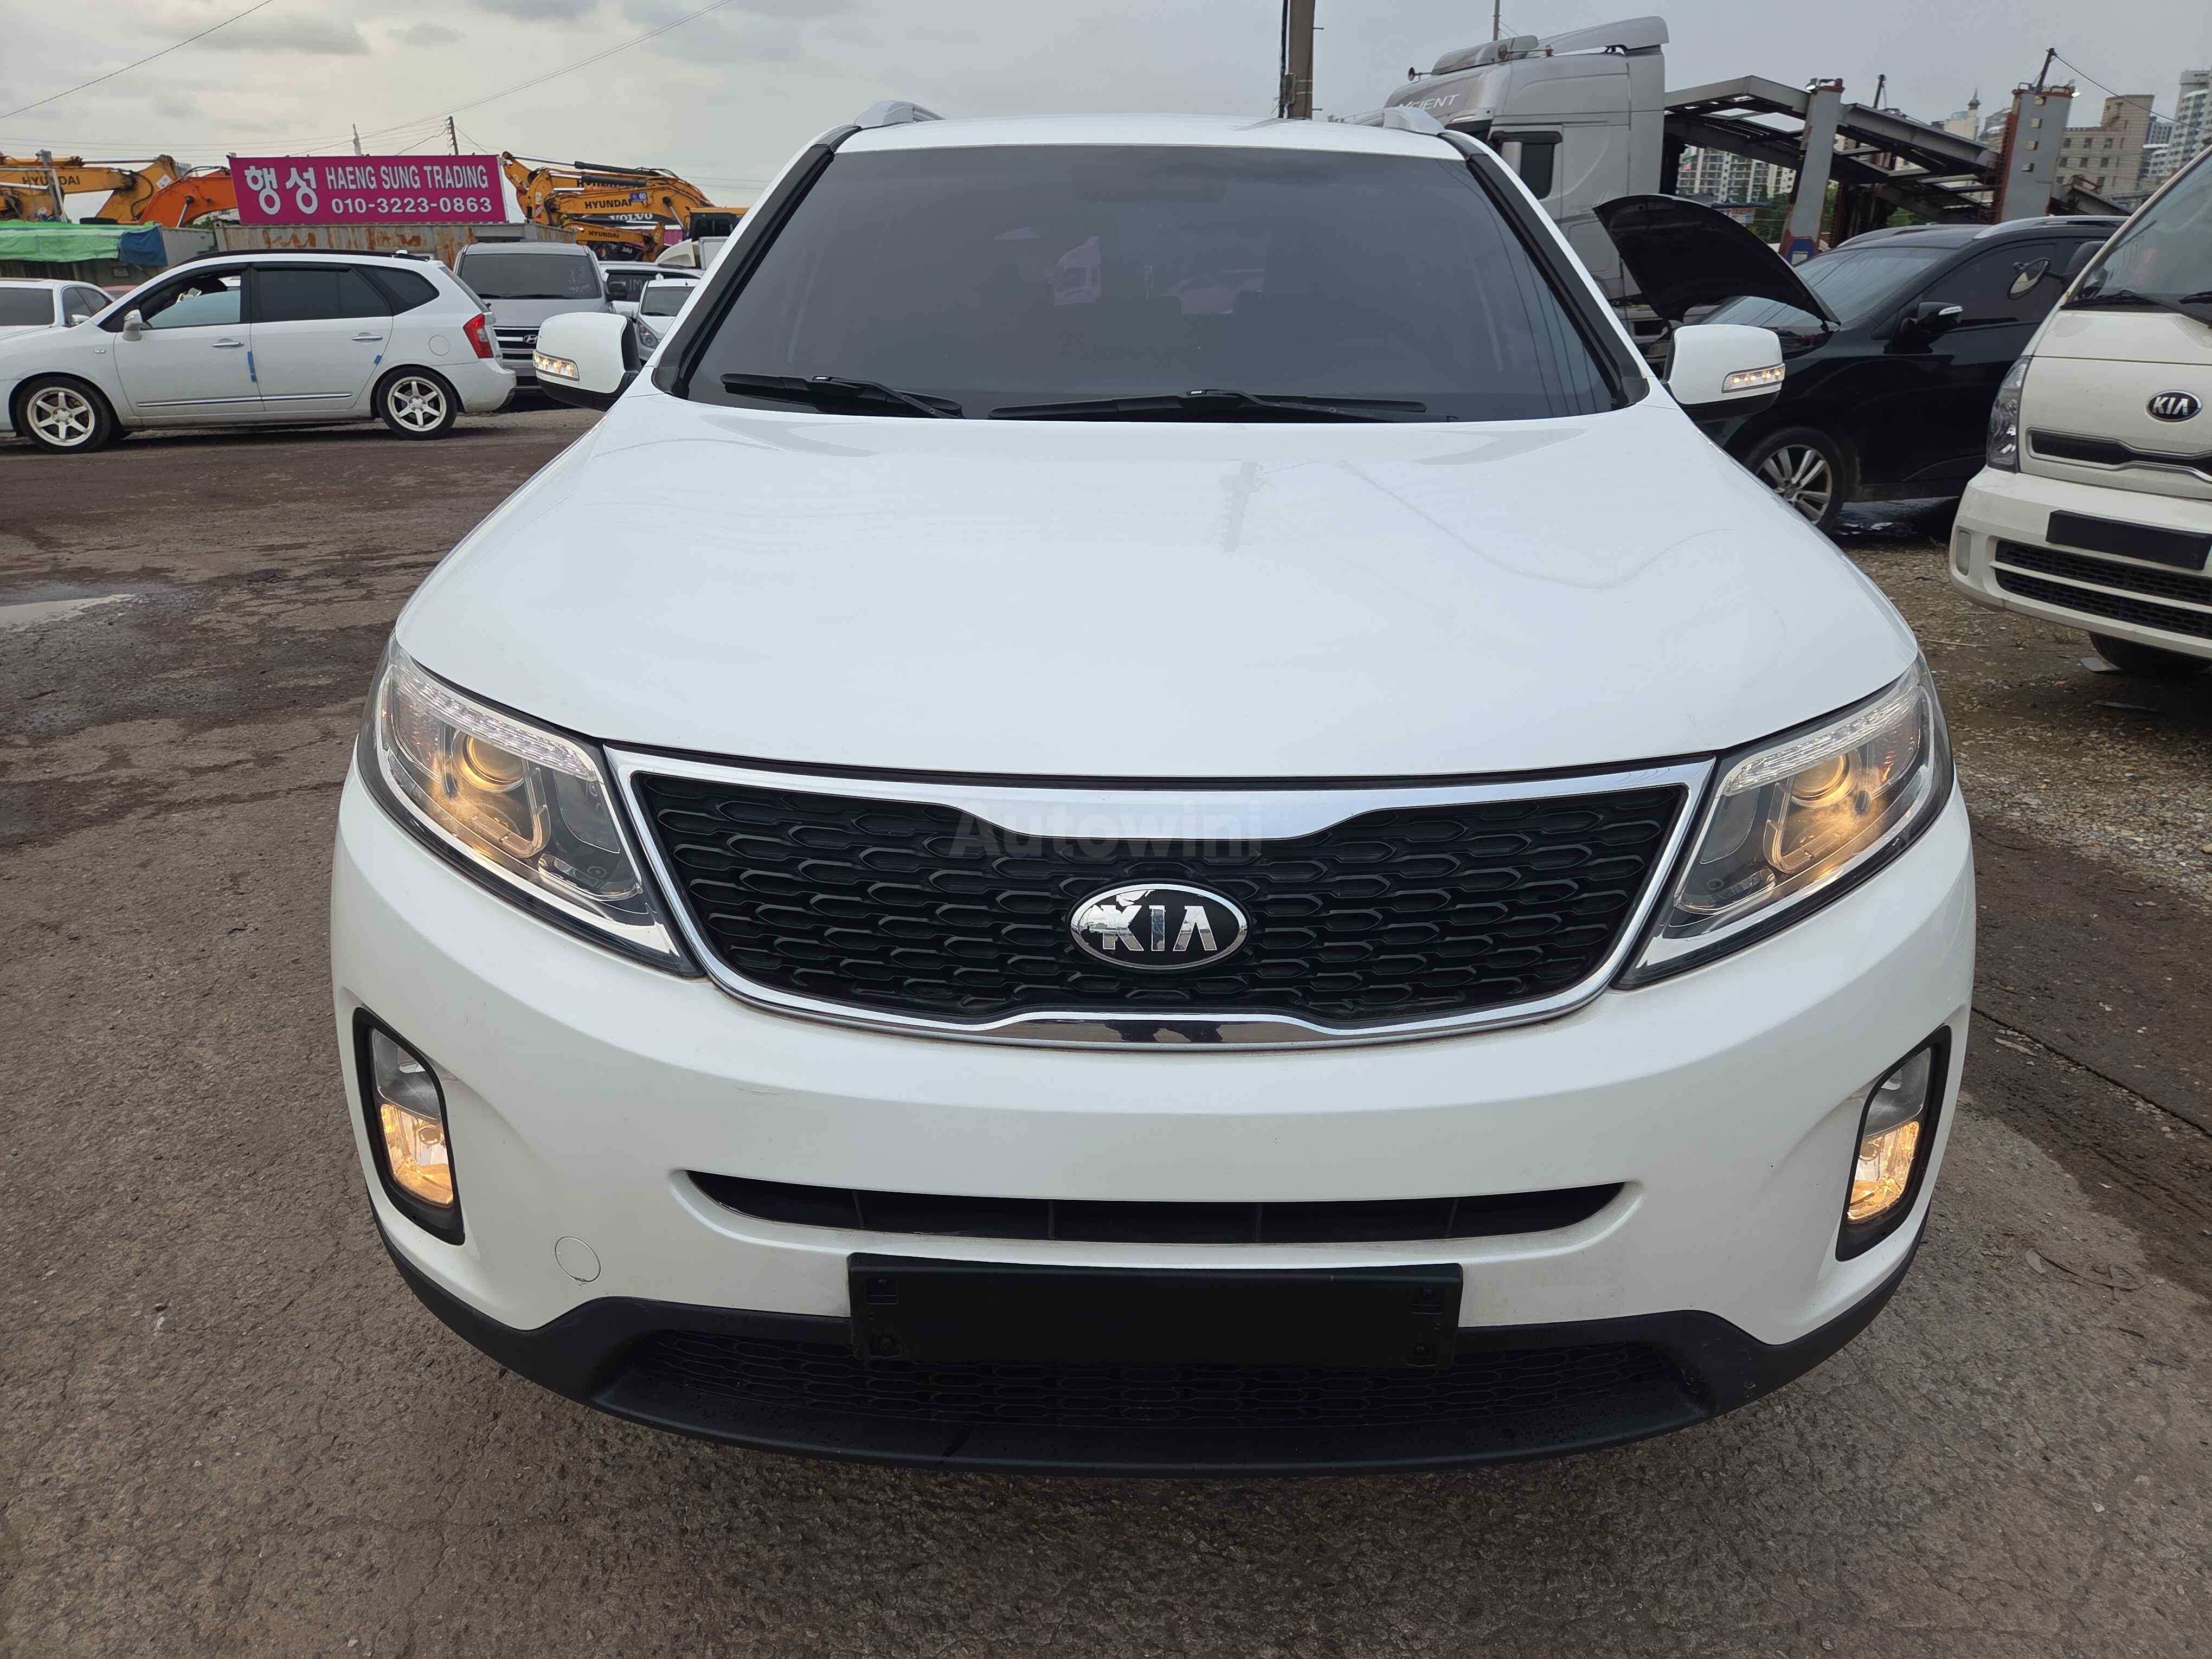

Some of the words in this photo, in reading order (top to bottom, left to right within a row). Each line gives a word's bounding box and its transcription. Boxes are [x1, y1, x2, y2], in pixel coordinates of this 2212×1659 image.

[22, 175, 81, 186] HYUDAI
[325, 166, 377, 190] HAENG
[380, 165, 421, 189] SUNG
[423, 164, 489, 189] TRADING
[331, 197, 492, 214] 010-3223-0863
[584, 199, 632, 209] HYUNDAI
[608, 213, 653, 222] VOLVO
[589, 230, 620, 239] HYUNDAI
[2152, 396, 2189, 415] KIA
[1101, 904, 1218, 951] KIA
